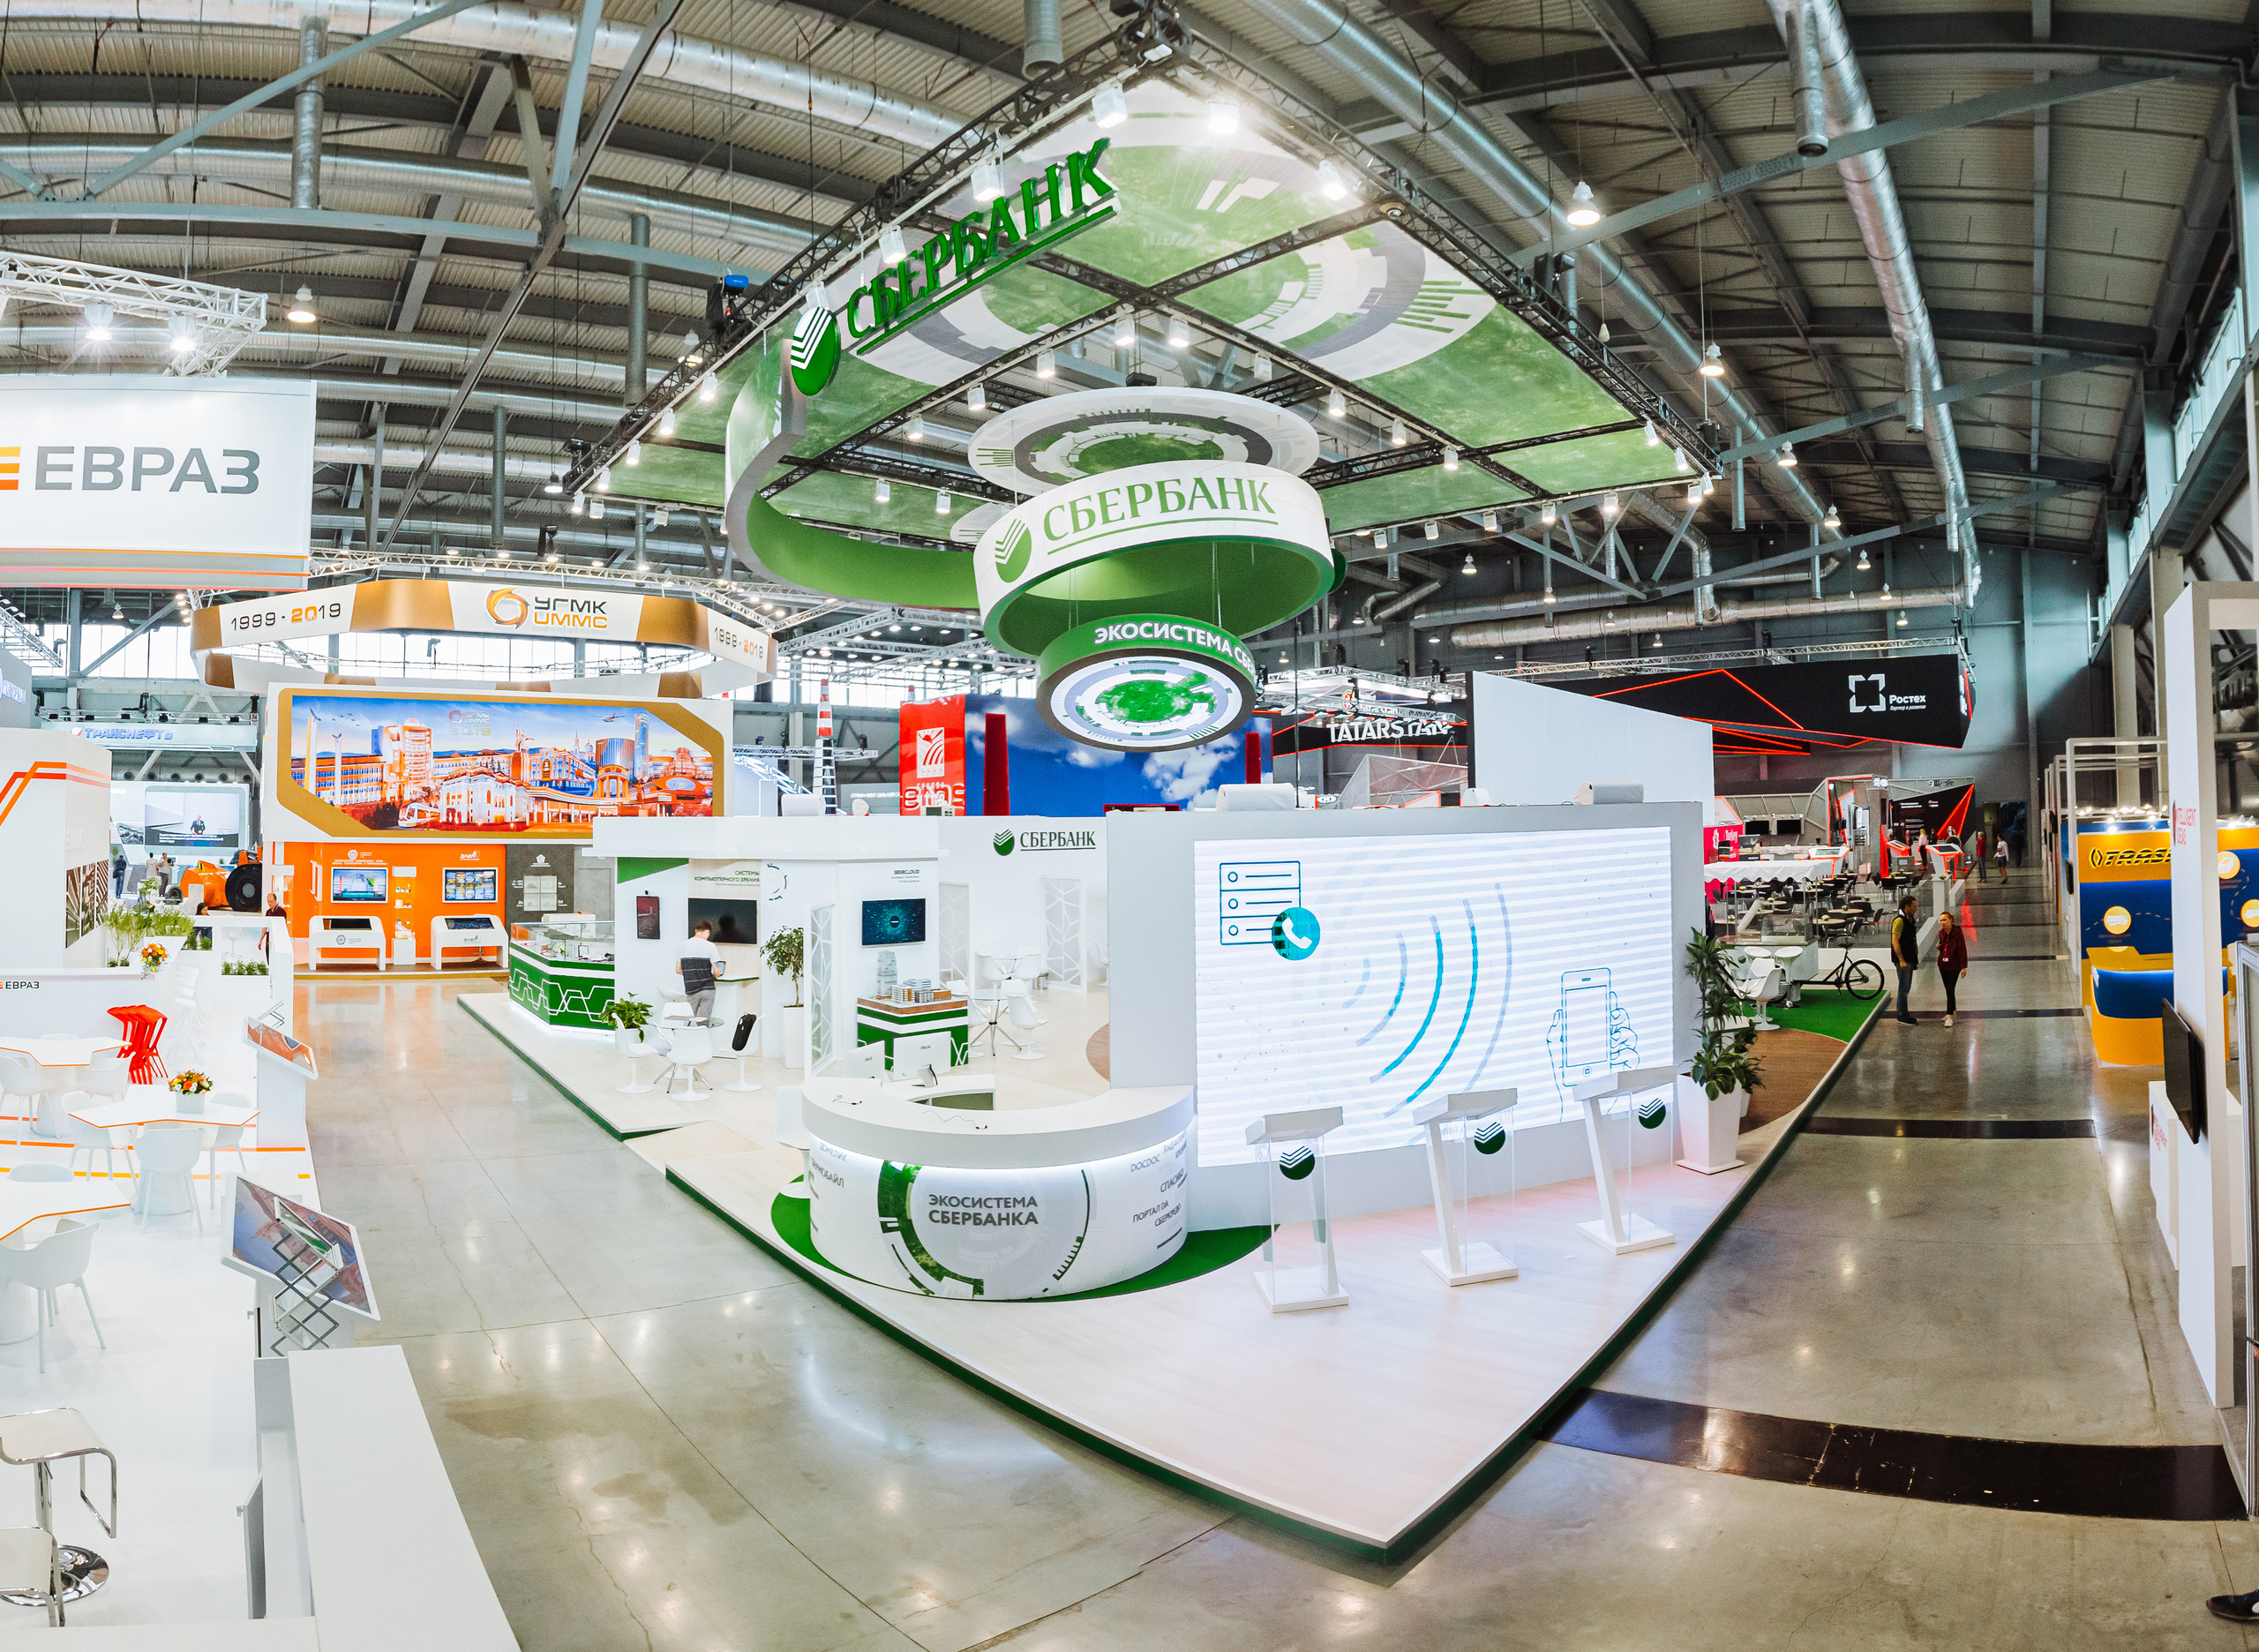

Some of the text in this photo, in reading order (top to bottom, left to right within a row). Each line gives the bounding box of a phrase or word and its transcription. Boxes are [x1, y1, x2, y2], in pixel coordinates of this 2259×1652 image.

[846, 137, 1115, 339] СБЕРБАНК
[35, 446, 261, 495] ЕВРАЗ
[1043, 477, 1277, 542] СБЕРБАНК
[534, 596, 608, 615] УГМК
[230, 612, 276, 632] 1999
[290, 602, 341, 623] 2019
[534, 612, 608, 629] UMMC
[1093, 621, 1257, 680] ЭКОСИСТЕМА СБЕ
[1889, 695, 1926, 704] Ростех
[84, 727, 174, 740] ТРАНСНЕФТЬ
[1020, 831, 1096, 848] СБЕРБАНК
[1130, 1154, 1160, 1172] DOCDOC
[928, 1194, 1039, 1209] ЭКОСИСТЕМА
[928, 1209, 1039, 1226] СБЕРБАНКА
[1133, 1205, 1160, 1223] ПОРТАЛ
